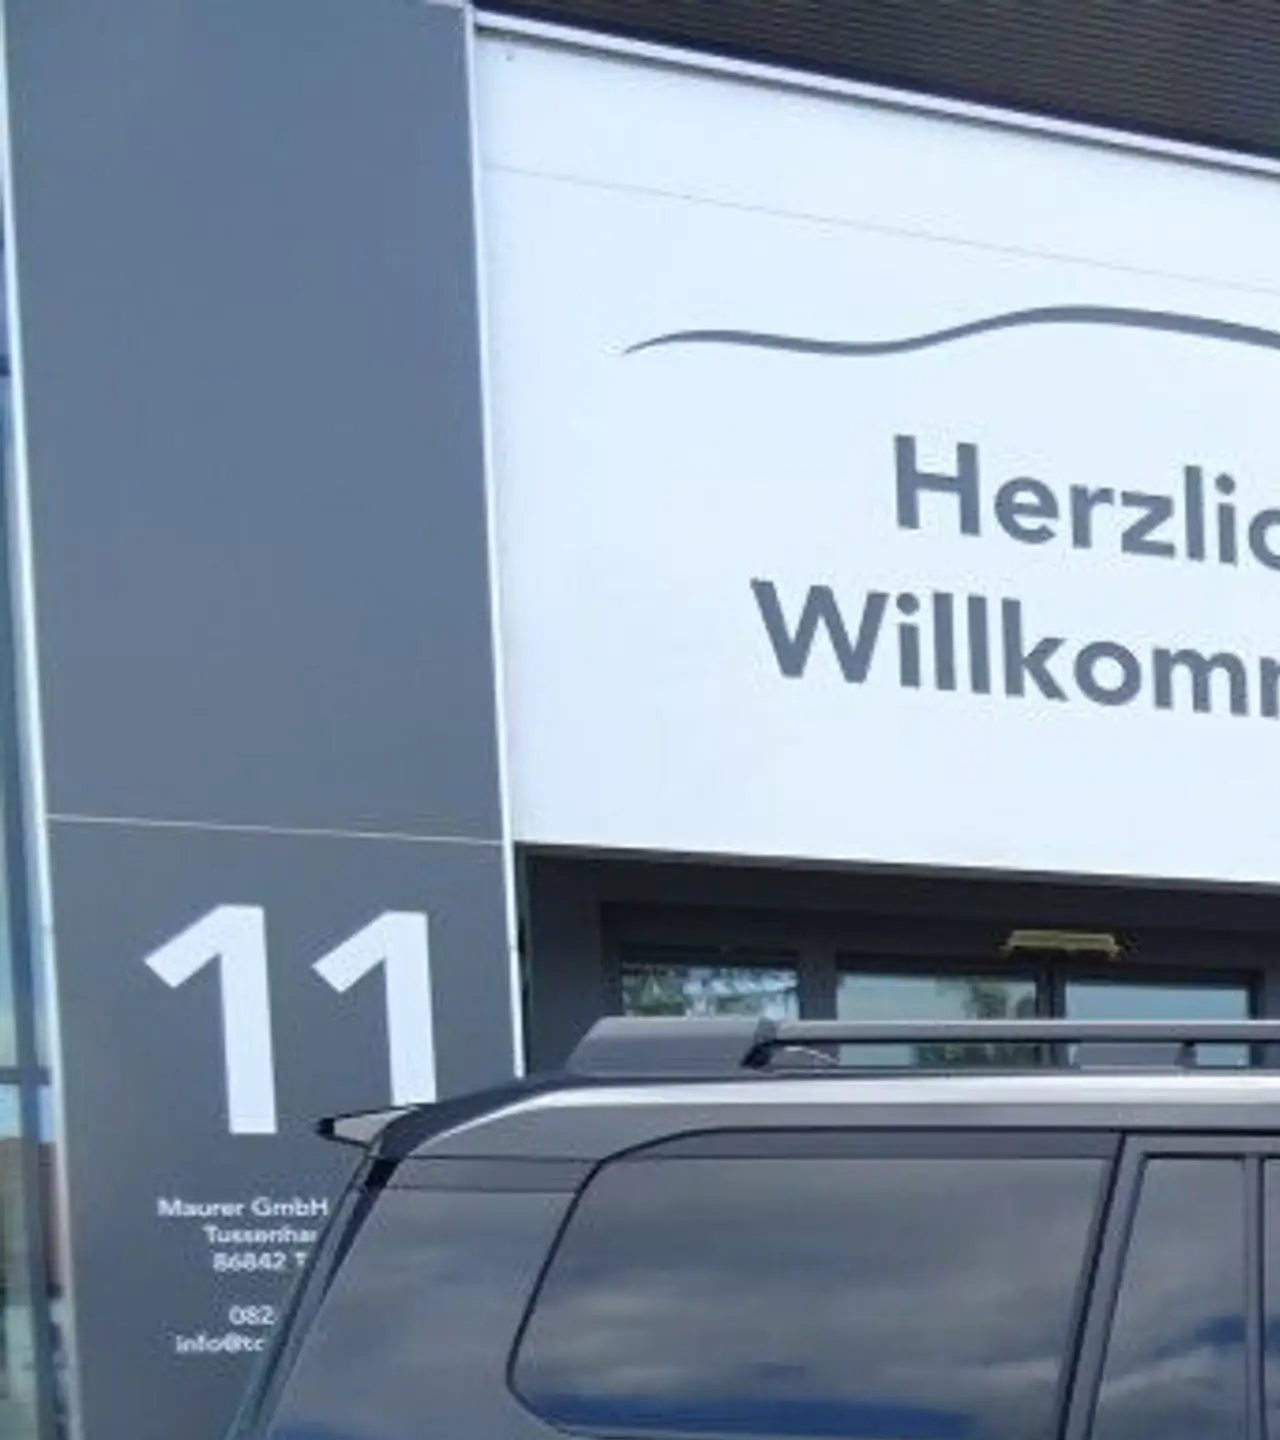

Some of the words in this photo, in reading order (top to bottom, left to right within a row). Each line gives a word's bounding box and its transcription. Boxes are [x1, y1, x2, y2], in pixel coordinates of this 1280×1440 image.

[144, 904, 437, 1135] 11
[157, 1198, 244, 1217] Maurer
[251, 1197, 329, 1217] GmbH
[212, 1252, 287, 1272] 86842
[229, 1305, 275, 1325] 082
